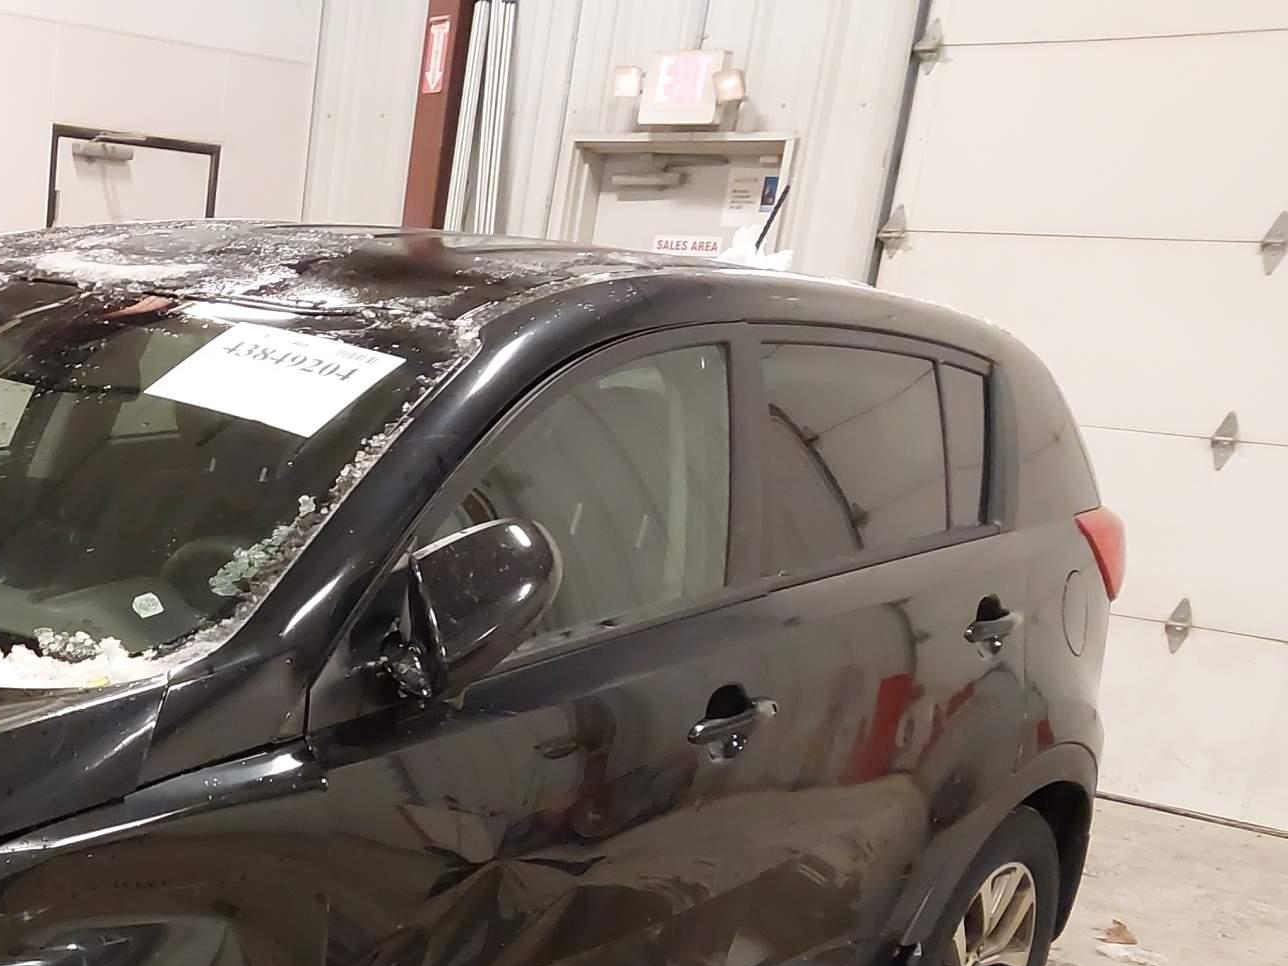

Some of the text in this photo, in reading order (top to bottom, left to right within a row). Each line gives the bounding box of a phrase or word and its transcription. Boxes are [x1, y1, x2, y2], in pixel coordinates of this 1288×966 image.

[655, 55, 713, 102] ET
[656, 239, 718, 252] SALES AREA
[223, 341, 359, 381] 43849204
